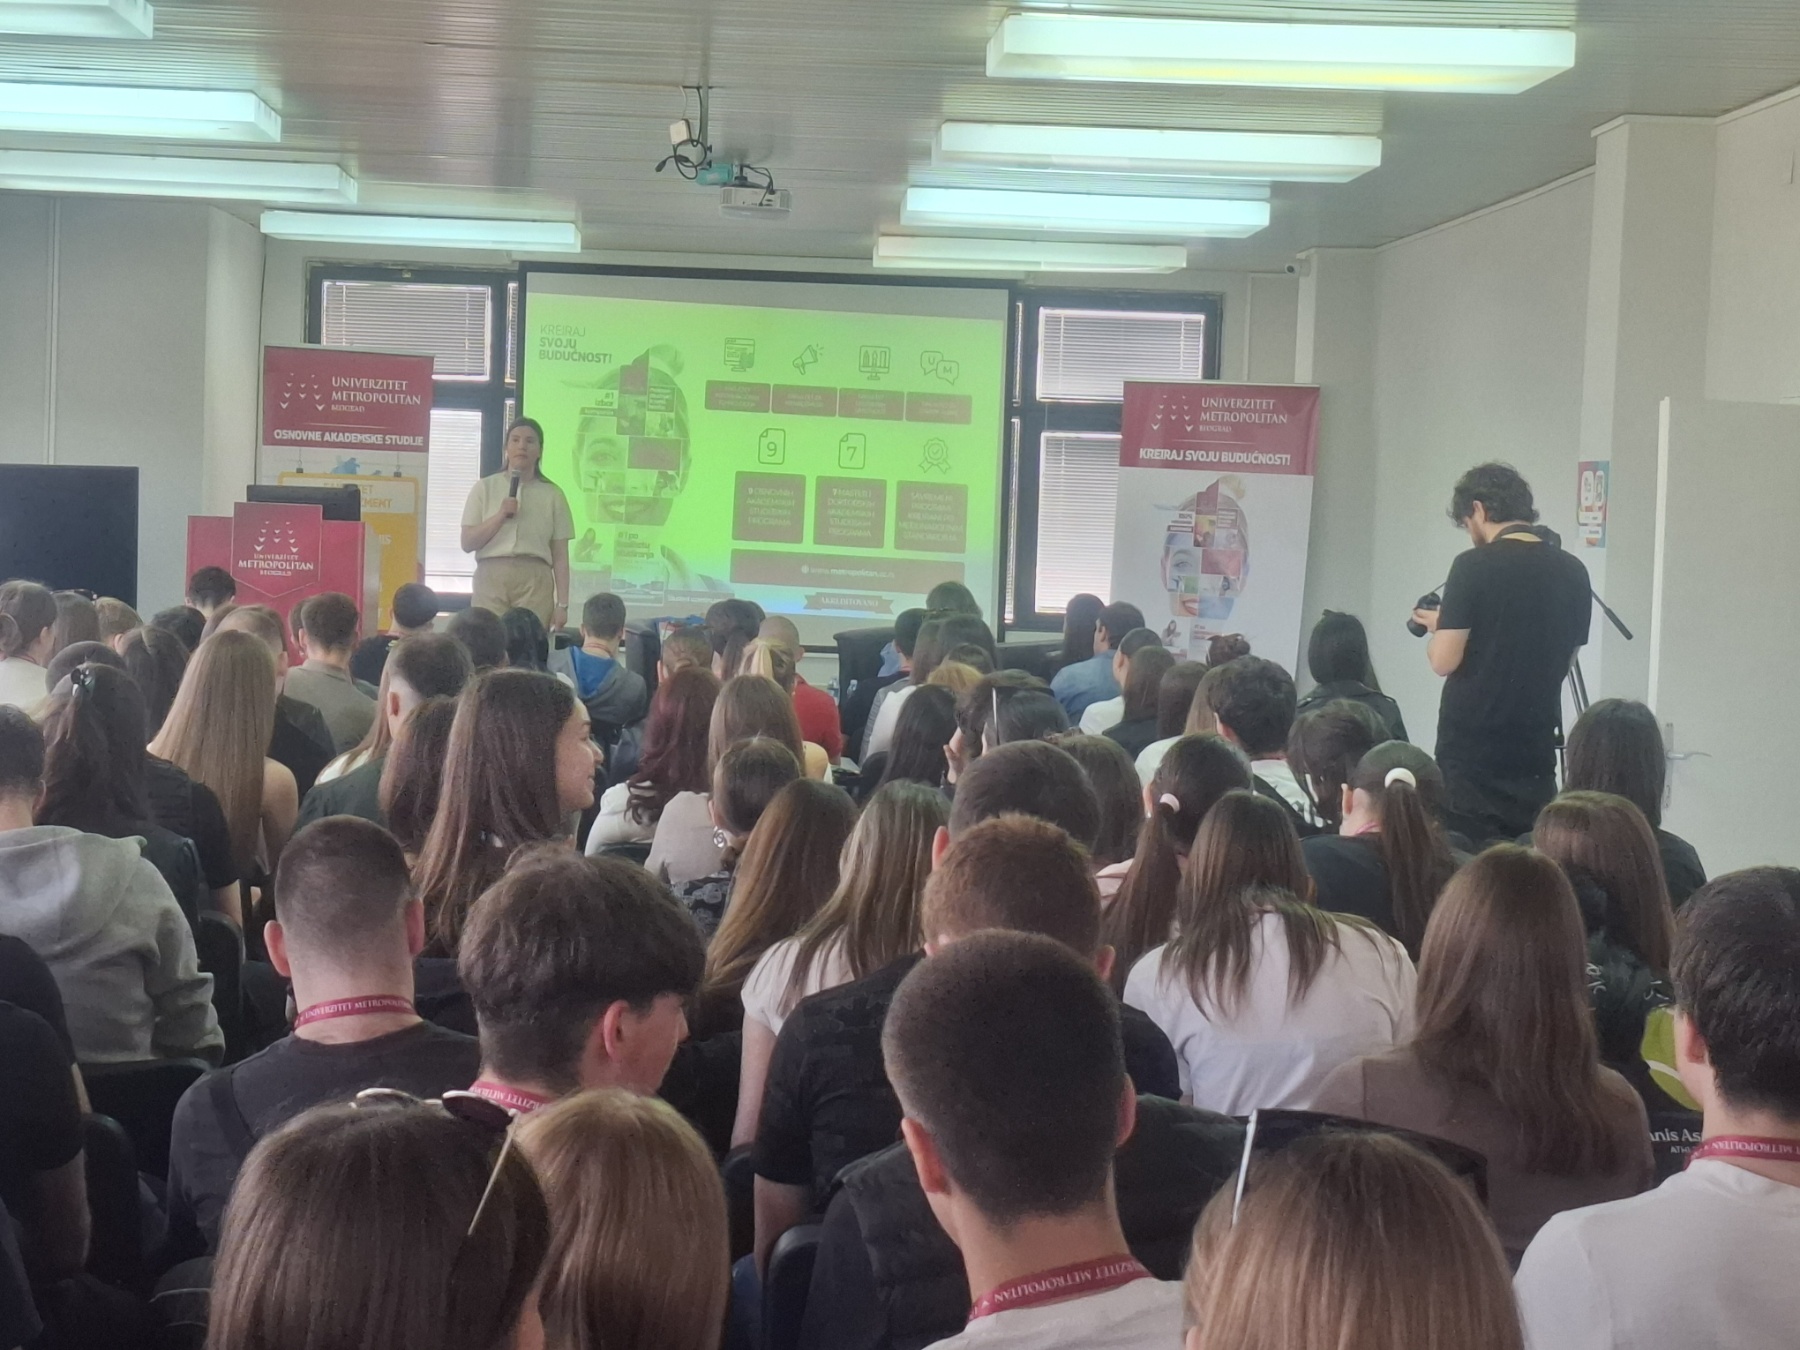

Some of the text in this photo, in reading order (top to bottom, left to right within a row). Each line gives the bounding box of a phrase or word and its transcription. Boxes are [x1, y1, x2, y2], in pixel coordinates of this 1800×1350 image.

[540, 324, 586, 337] KREIRAJ
[539, 337, 577, 349] SVOJU
[331, 376, 408, 391] UNIVERZITET
[331, 391, 421, 405] METROPOLITAN
[1201, 397, 1275, 410] UNIVERZITET
[1200, 411, 1288, 424] METROPOLITAN
[273, 429, 322, 441] OSNOVNE
[323, 431, 384, 444] AKADEMSKE
[384, 434, 424, 446] STUDIJE
[766, 441, 778, 457] 9
[846, 446, 857, 462] 7
[1140, 448, 1185, 461] KREIRAJ
[1185, 450, 1219, 462] SVOJU
[253, 553, 299, 561] UNIVERZITET
[238, 560, 314, 570] METROPOLITAN
[305, 1002, 352, 1018] UNIVERZITET
[1681, 1128, 1703, 1142] As
[1711, 1140, 1793, 1154] METROPOLITAN
[993, 1270, 1091, 1304] METROPOLITAN
